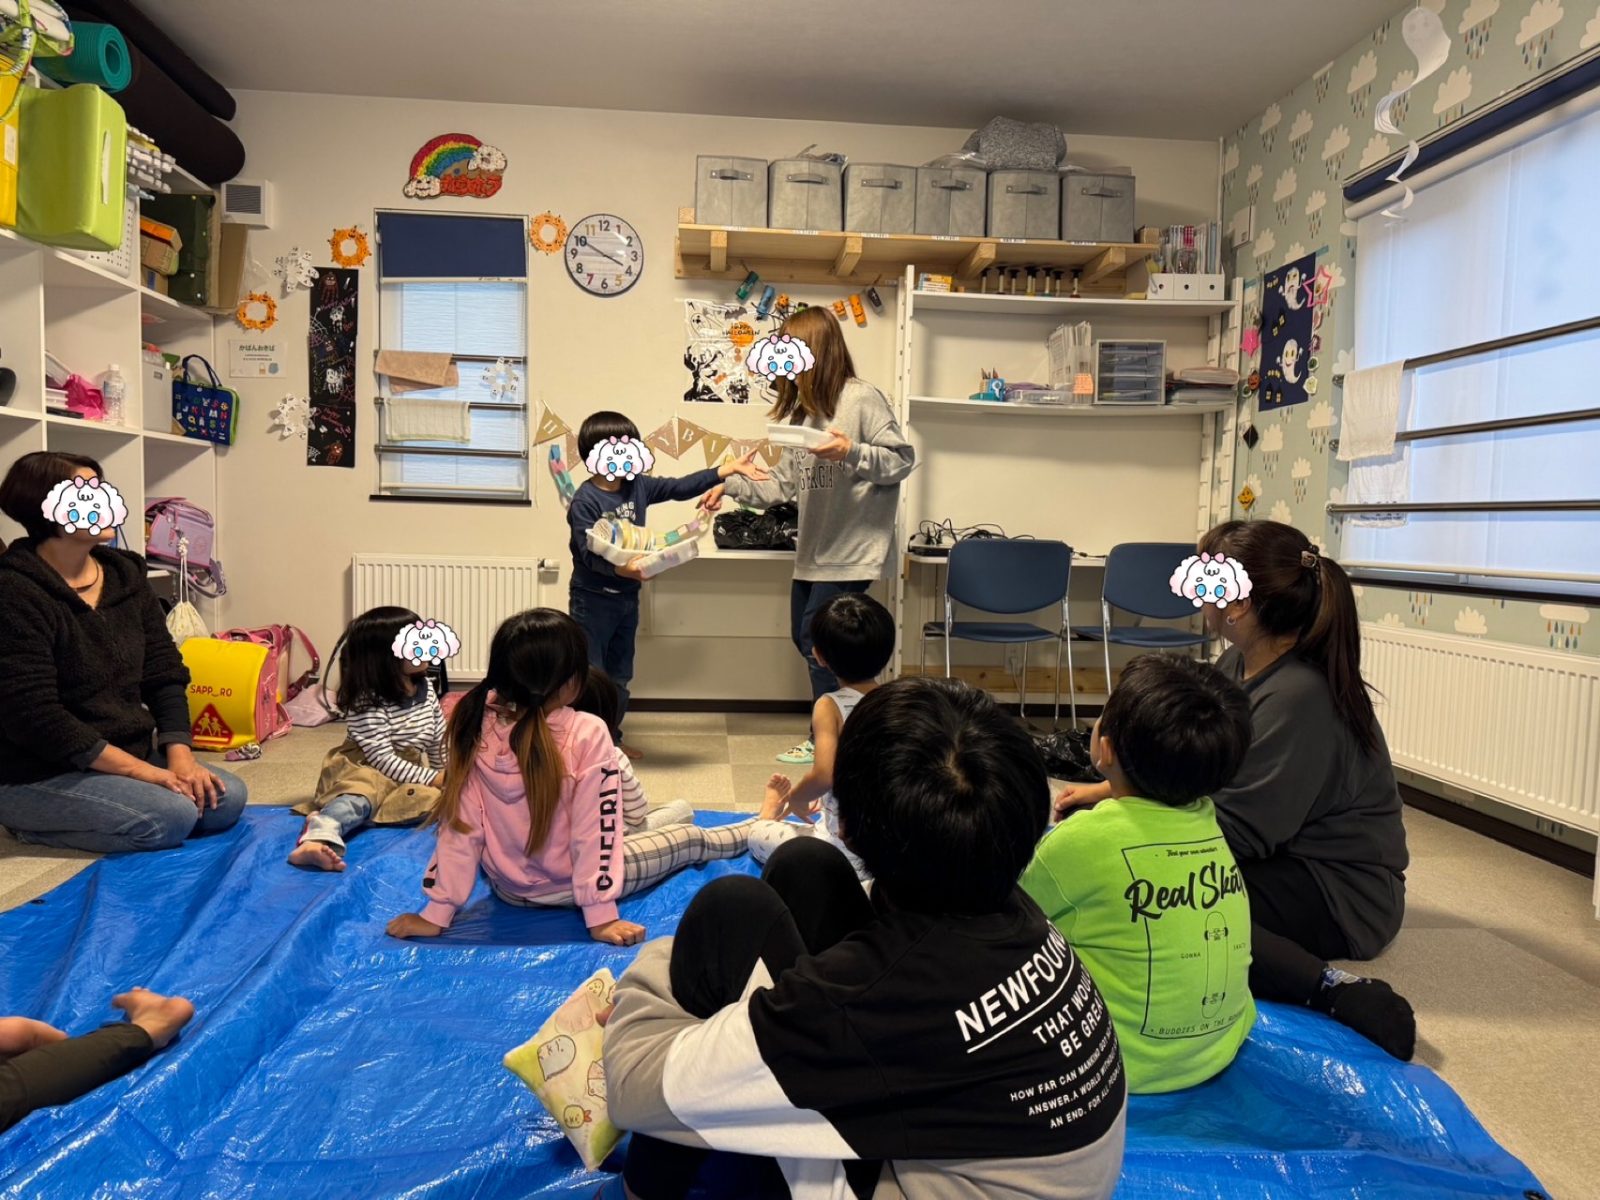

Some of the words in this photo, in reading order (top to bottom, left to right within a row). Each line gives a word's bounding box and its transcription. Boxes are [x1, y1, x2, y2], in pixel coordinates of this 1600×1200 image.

[584, 223, 596, 236] 11
[598, 219, 610, 232] 12
[615, 224, 622, 235] 1
[573, 235, 587, 247] 10
[625, 235, 633, 247] 2
[570, 247, 579, 260] 9
[630, 250, 638, 262] 3
[575, 262, 584, 274] 8
[624, 265, 633, 277] 4
[586, 273, 595, 286] 7
[600, 277, 609, 290] 6
[614, 273, 623, 287] 5
[1124, 872, 1198, 923] Real
[1032, 1003, 1074, 1045] THAT
[1060, 1030, 1083, 1058] BE
[1009, 1087, 1035, 1102] HOW
[1038, 1079, 1057, 1094] FAR
[1059, 1069, 1077, 1086] CAN
[1079, 1072, 1101, 1095] WORLD
[1050, 1115, 1064, 1129] AN
[1088, 1094, 1101, 1111] FOR
